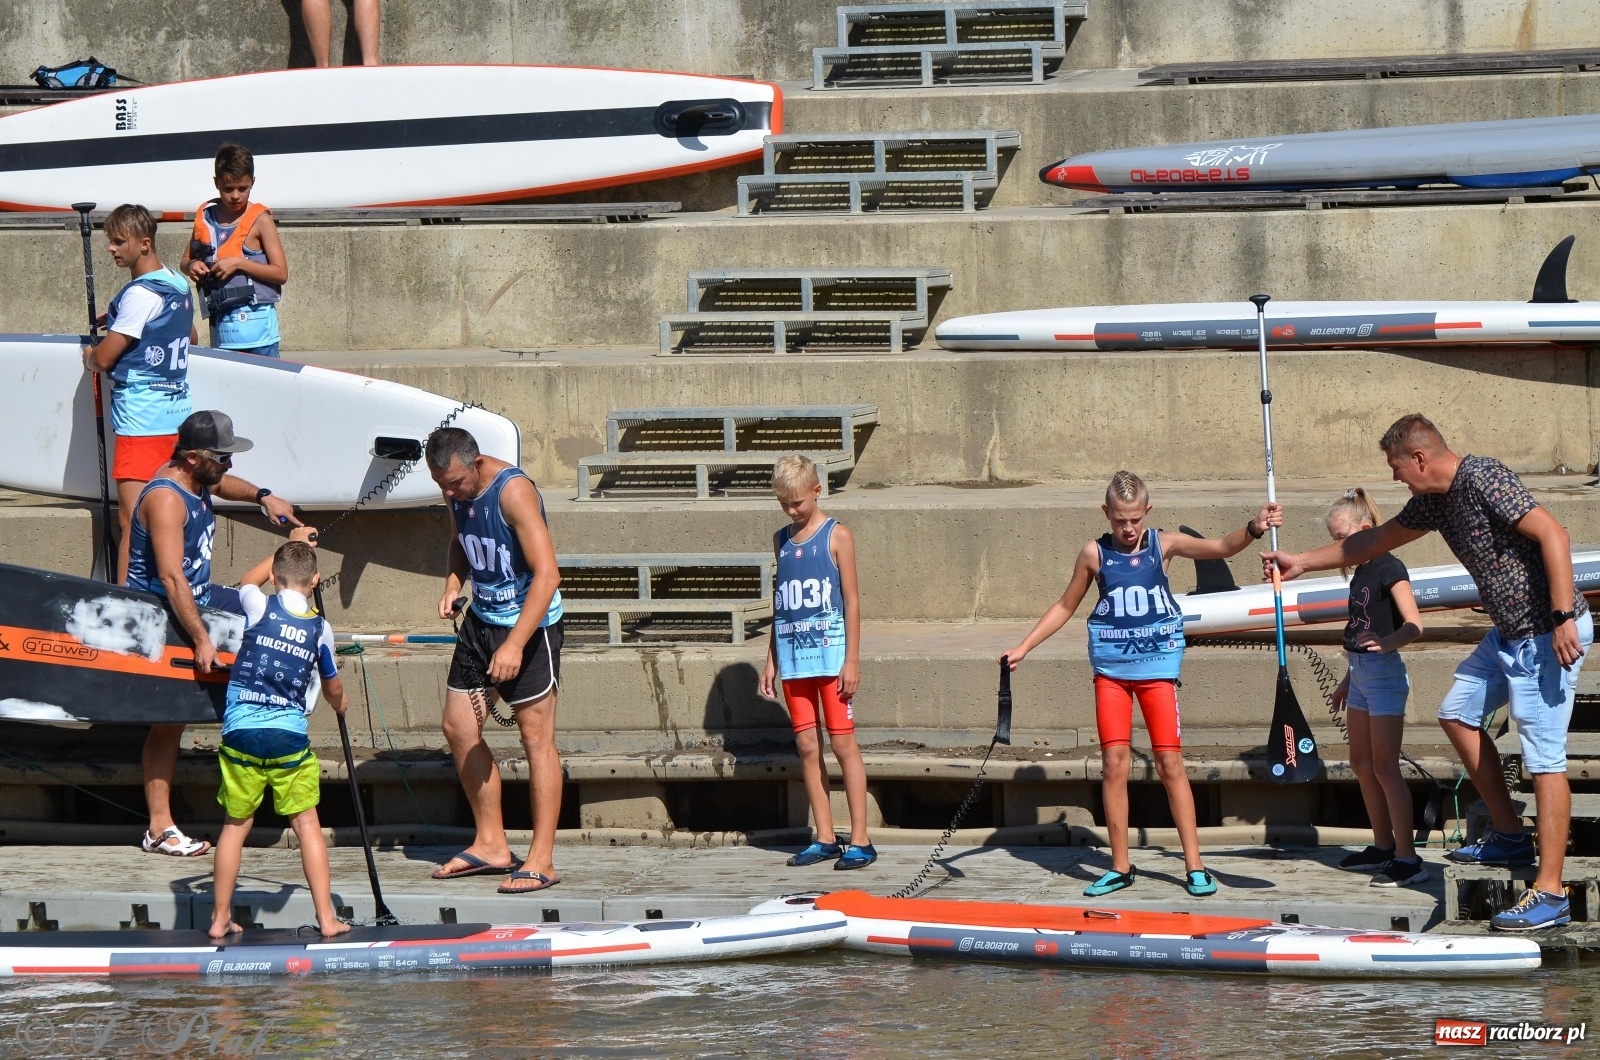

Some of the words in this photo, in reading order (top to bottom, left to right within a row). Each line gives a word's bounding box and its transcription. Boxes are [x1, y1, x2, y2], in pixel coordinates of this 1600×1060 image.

[115, 98, 127, 131] BASS
[779, 578, 820, 611] 103
[1108, 585, 1166, 618] 101
[256, 634, 310, 661] KULCZYCKI
[280, 624, 308, 644] 106
[974, 941, 1020, 951] GLADIATOR
[223, 962, 272, 972] GLADIATOR
